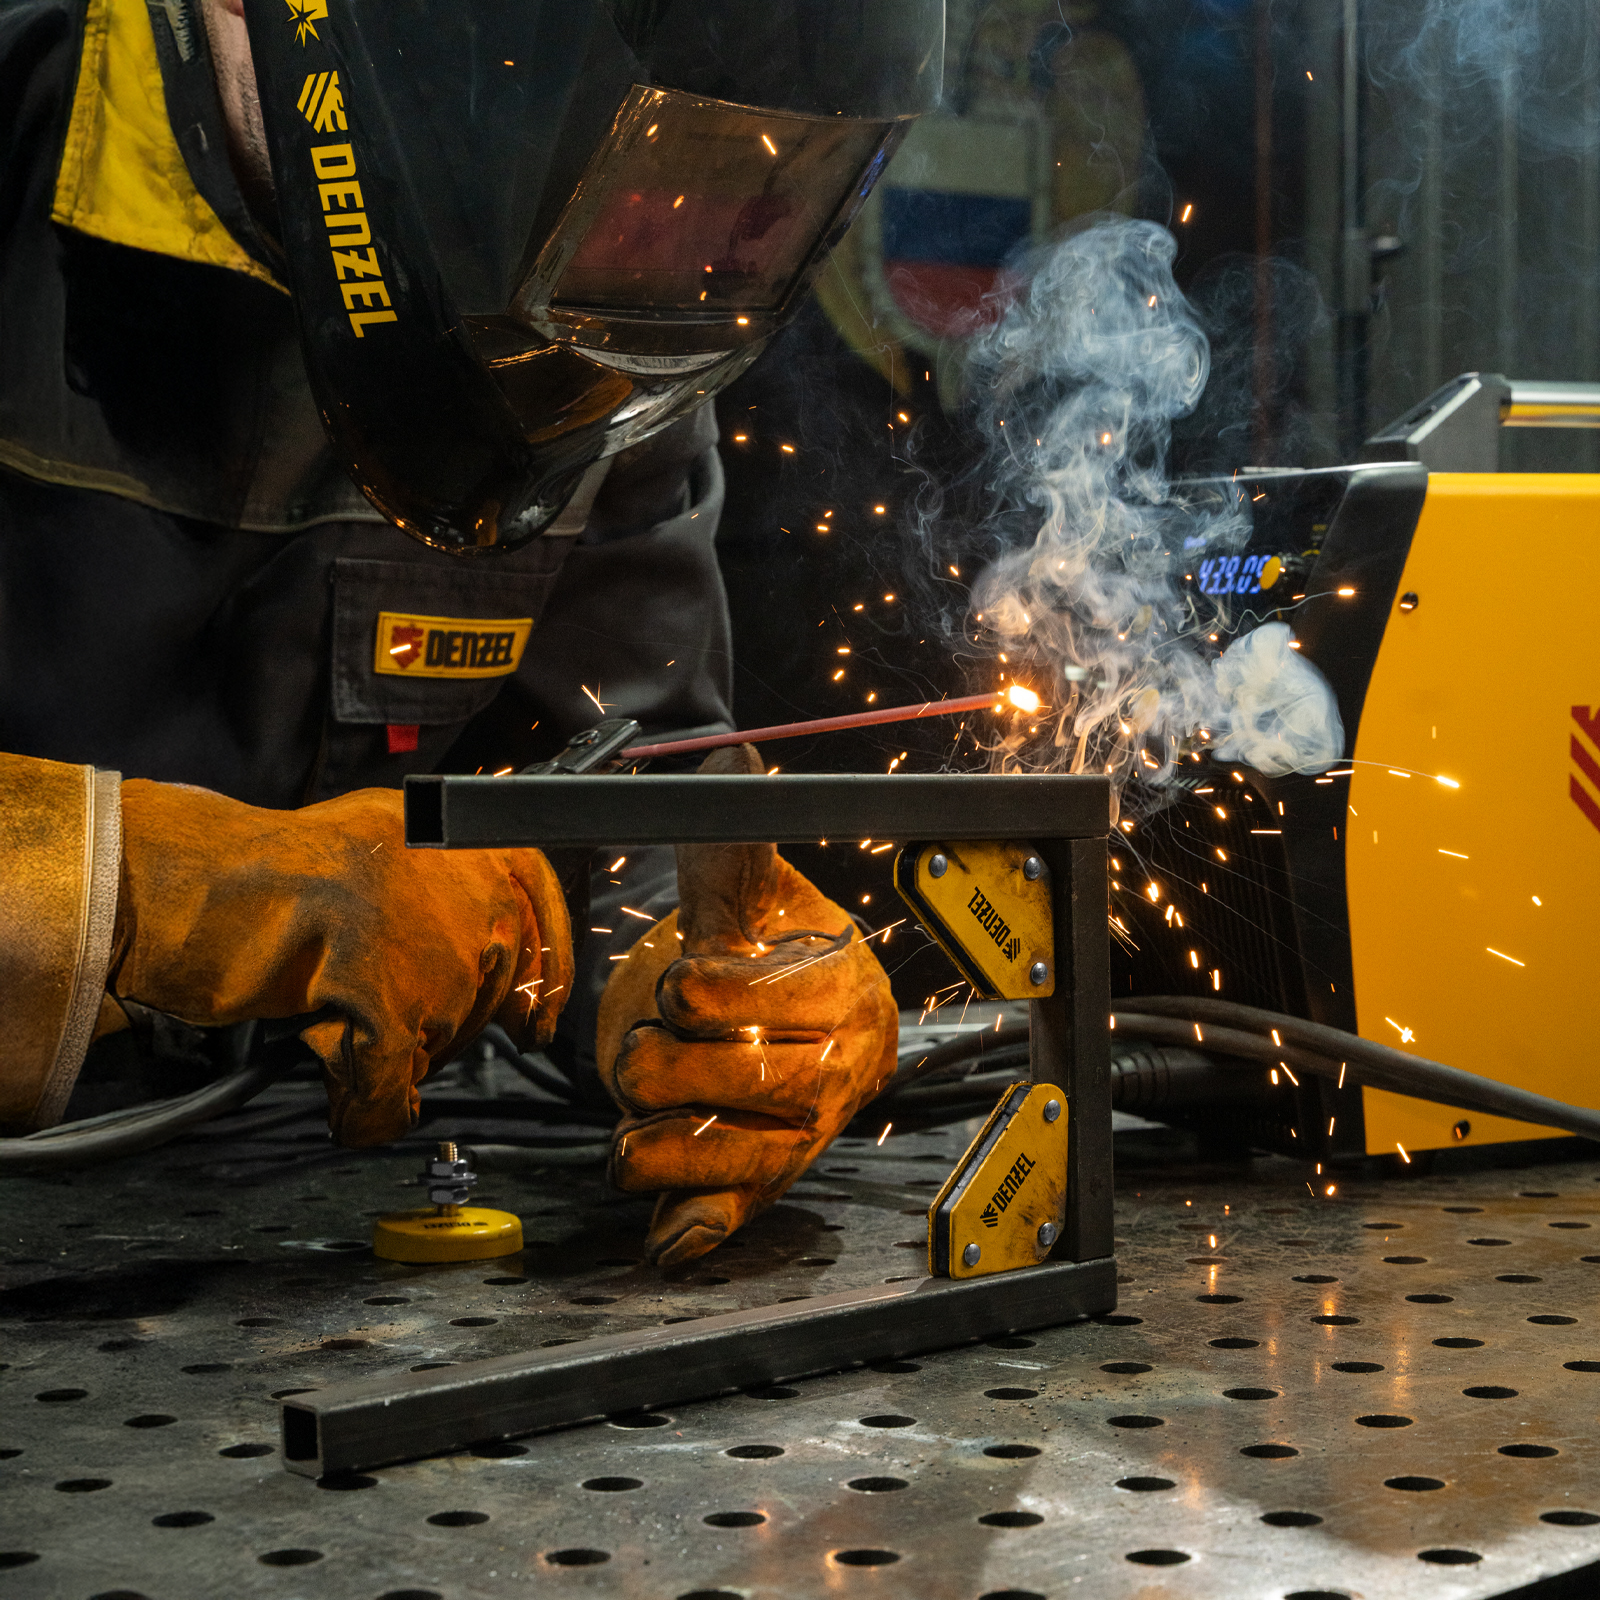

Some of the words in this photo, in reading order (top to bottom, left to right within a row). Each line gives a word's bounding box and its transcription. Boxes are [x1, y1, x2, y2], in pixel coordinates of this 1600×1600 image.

[310, 143, 398, 338] DENZEL
[424, 629, 516, 668] DENZEL
[967, 886, 1011, 948] DENZEL
[991, 1152, 1036, 1213] DENZEL
